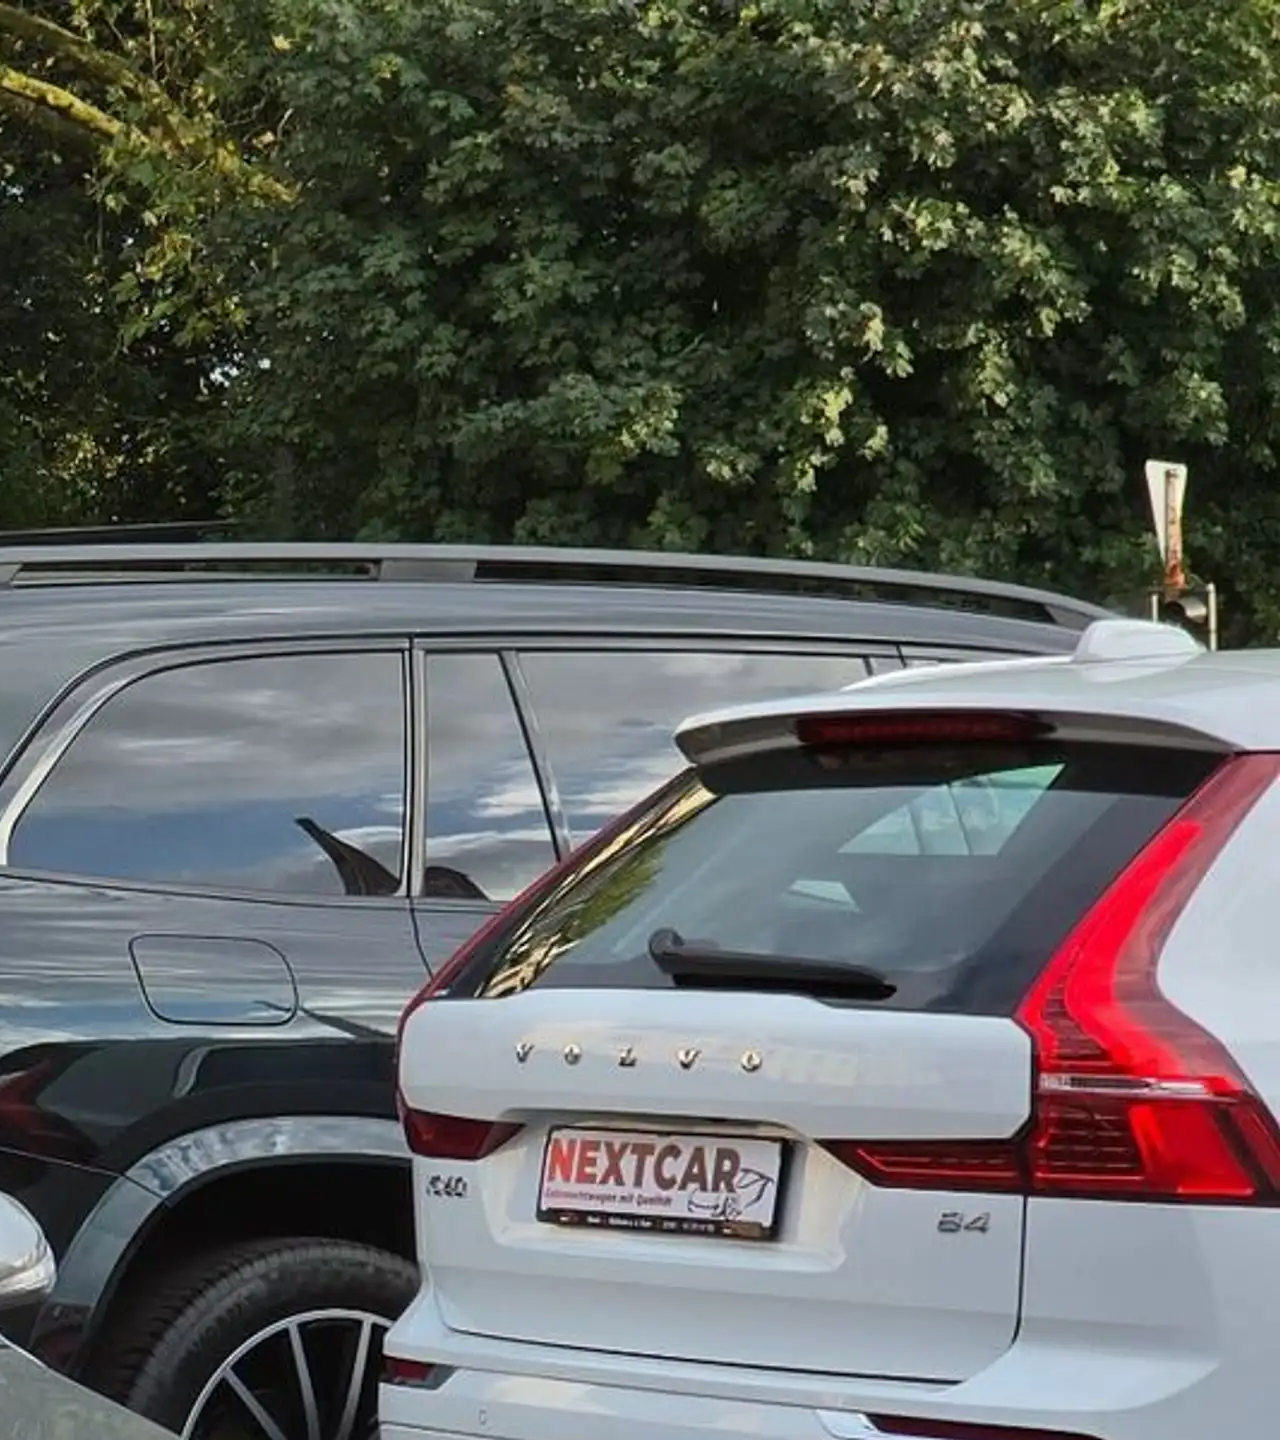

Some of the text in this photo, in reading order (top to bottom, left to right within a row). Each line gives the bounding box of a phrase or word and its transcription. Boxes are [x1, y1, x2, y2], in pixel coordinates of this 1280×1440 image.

[516, 1042, 763, 1073] VOLVO
[547, 1137, 742, 1193] NEXTCAR
[937, 1211, 990, 1234] B4
